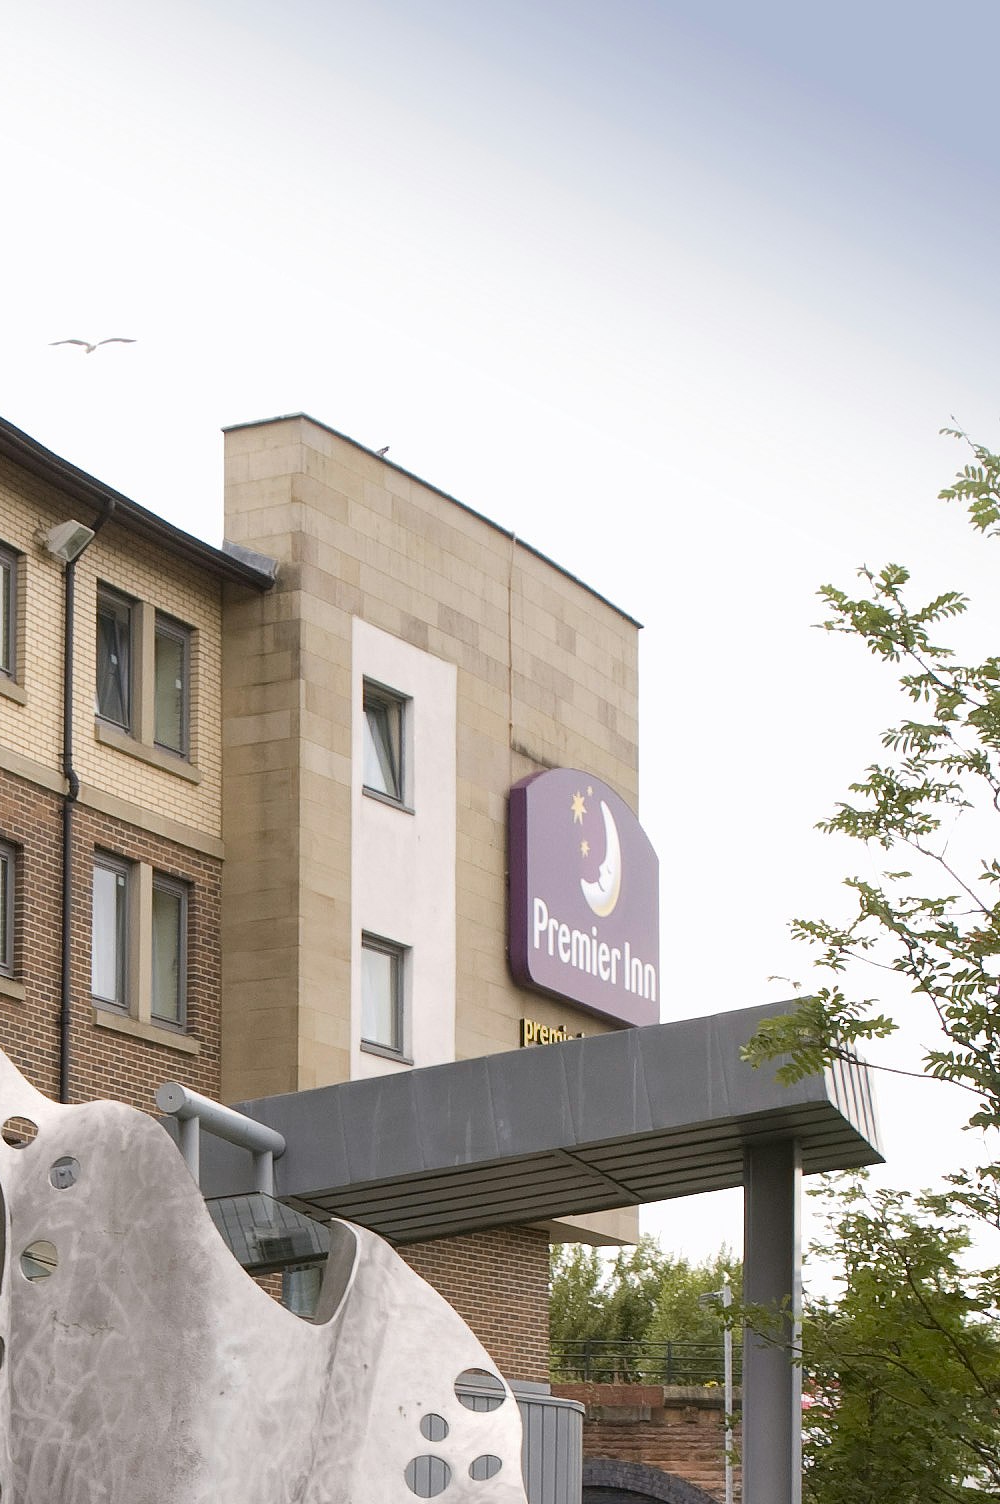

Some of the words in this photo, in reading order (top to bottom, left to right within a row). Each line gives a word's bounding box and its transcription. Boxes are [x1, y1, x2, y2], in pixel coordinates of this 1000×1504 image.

[534, 897, 621, 985] Premier
[624, 941, 656, 1002] Inn
[523, 1018, 573, 1047] premi
